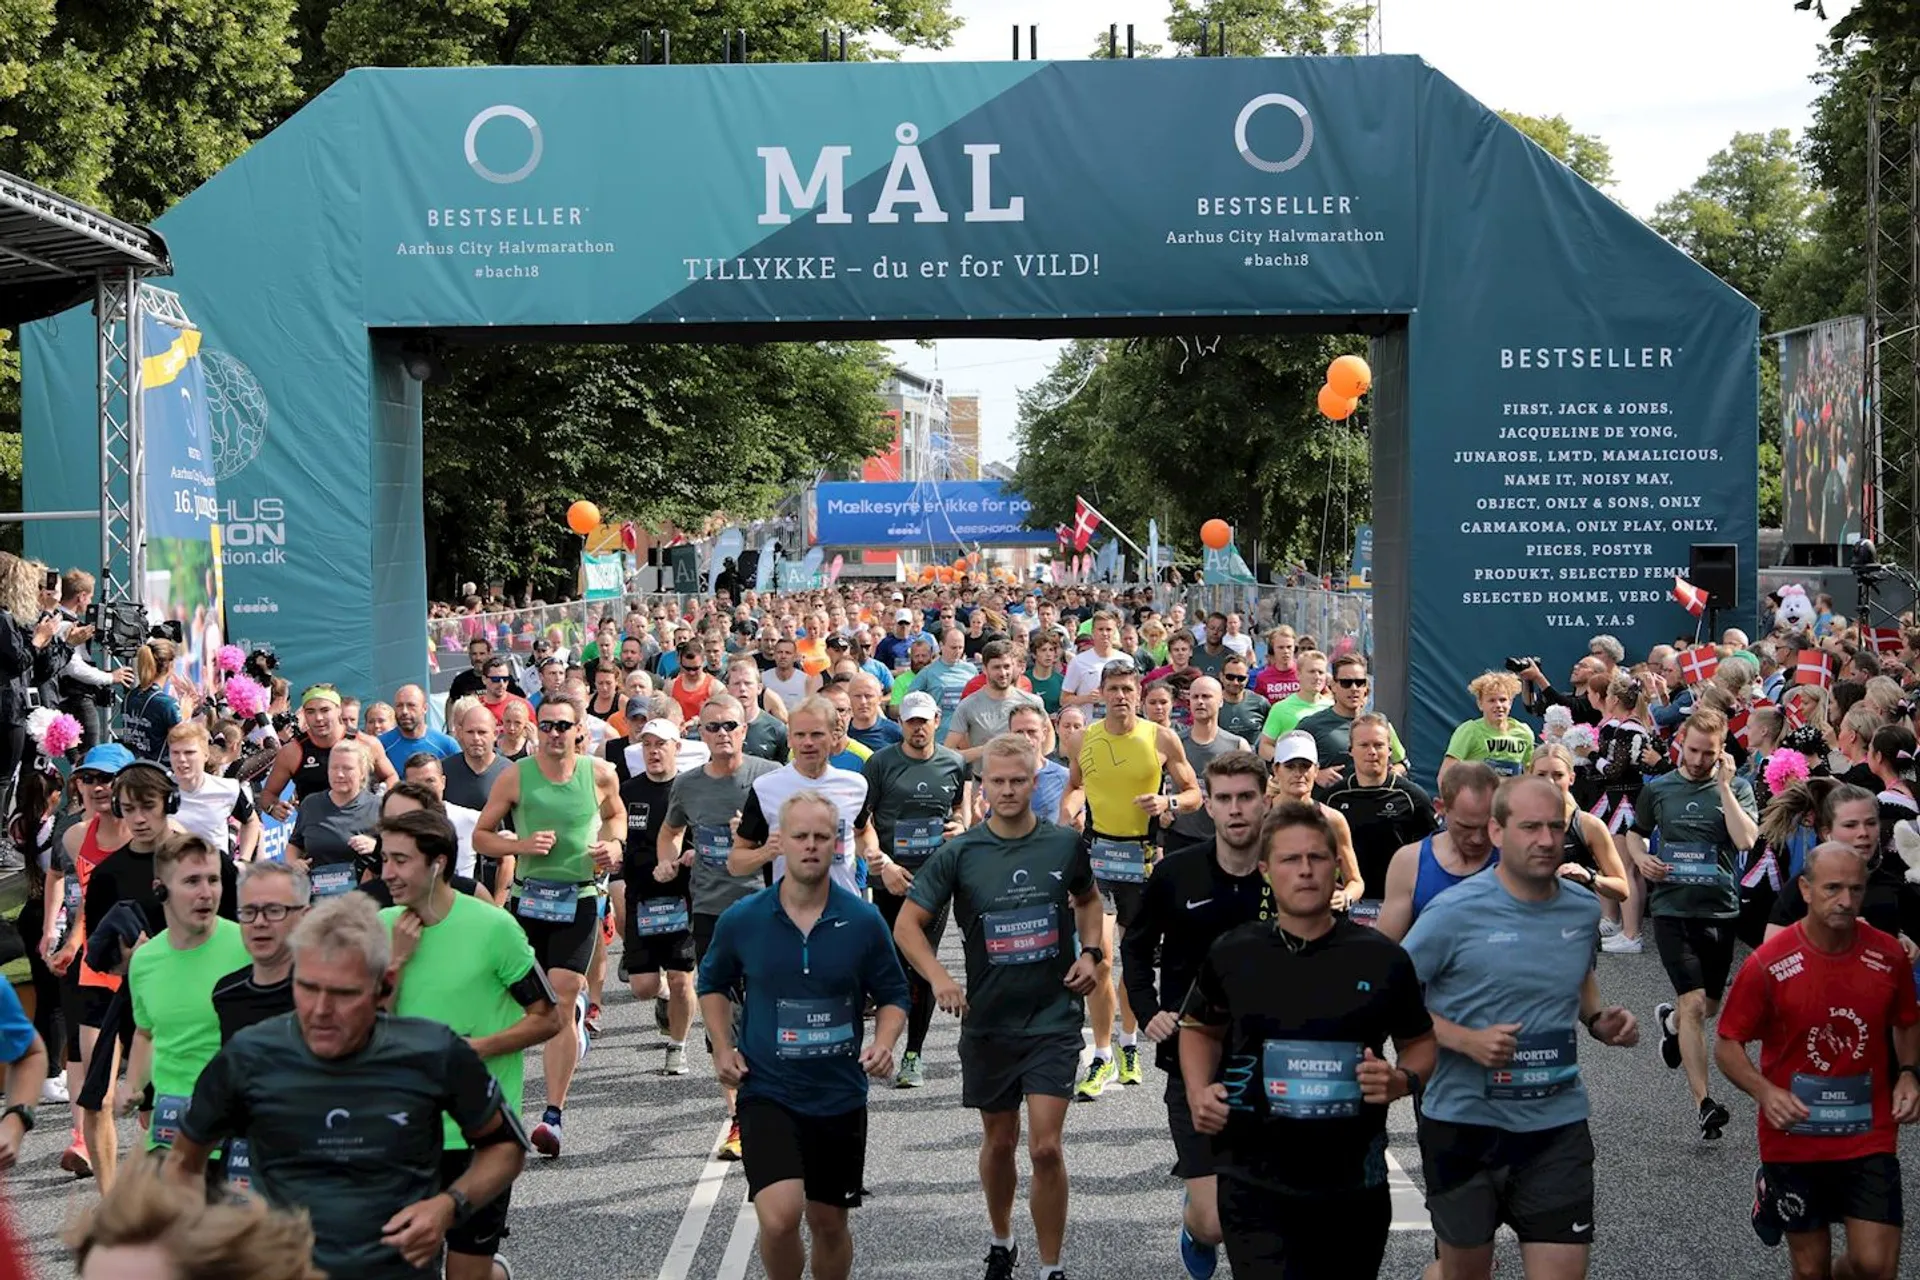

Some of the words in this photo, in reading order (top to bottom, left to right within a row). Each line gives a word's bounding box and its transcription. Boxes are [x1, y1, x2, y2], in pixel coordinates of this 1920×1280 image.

[757, 122, 1025, 225] MÅL
[1198, 196, 1352, 215] BESTSELLER
[428, 208, 582, 227] BESTSELLER
[1166, 231, 1224, 244] Aarhus
[1229, 230, 1263, 245] City
[1269, 229, 1385, 242] Halvmarathon
[396, 242, 454, 255] Aarhus
[459, 242, 493, 257] City
[499, 241, 615, 254] Halvmarathon
[683, 257, 836, 281] TILLYKKE
[873, 256, 908, 280] du
[920, 260, 949, 279] er
[960, 255, 1004, 279] for
[1014, 253, 1100, 278] VILD!
[1244, 254, 1309, 267] #bach18
[475, 265, 540, 278] #bach18
[1501, 347, 1674, 368] BESTSELLER
[1503, 403, 1553, 416] FIRST,
[1558, 403, 1598, 416] JACK
[1603, 403, 1613, 416] &
[1618, 403, 1673, 416] JONES,
[1498, 426, 1599, 441] JACQUELINE
[1605, 426, 1624, 441] DE
[1630, 426, 1678, 441] YONG,
[1454, 449, 1543, 464] JUNAROSE,
[1548, 449, 1597, 464] LMTD,
[1602, 449, 1724, 464] MAMALICIOUS,
[1504, 473, 1551, 487] NAME
[1556, 473, 1577, 487] IT,
[1582, 473, 1630, 487] NOISY
[1636, 473, 1674, 487] MAY,
[945, 499, 978, 512] ikke
[982, 498, 1005, 512] for
[1477, 496, 1541, 511] OBJECT,
[1546, 496, 1588, 511] ONLY
[1593, 496, 1603, 511] &
[1608, 496, 1655, 511] SONS,
[1660, 496, 1702, 511] ONLY
[1460, 519, 1571, 534] CARMAKOMA,
[1576, 519, 1617, 534] ONLY
[1623, 519, 1667, 534] PLAY,
[1672, 519, 1718, 534] ONLY,
[1526, 544, 1587, 557] PIECES,
[1592, 544, 1653, 557] POSTYR
[1474, 568, 1554, 582] PRODUKT,
[1559, 567, 1639, 579] SELECTED
[1463, 590, 1543, 604] SELECTED
[1548, 590, 1614, 604] HOMME,
[1619, 590, 1660, 604] VERO
[1546, 613, 1590, 627] VILA,
[1595, 613, 1636, 627] Y.A.S
[994, 917, 1049, 934] KRISTOFFER
[806, 1013, 832, 1024] LINE
[1513, 1048, 1559, 1061] MORTEN
[1287, 1058, 1343, 1072] MORTEN
[1821, 1091, 1848, 1100] EMIL
